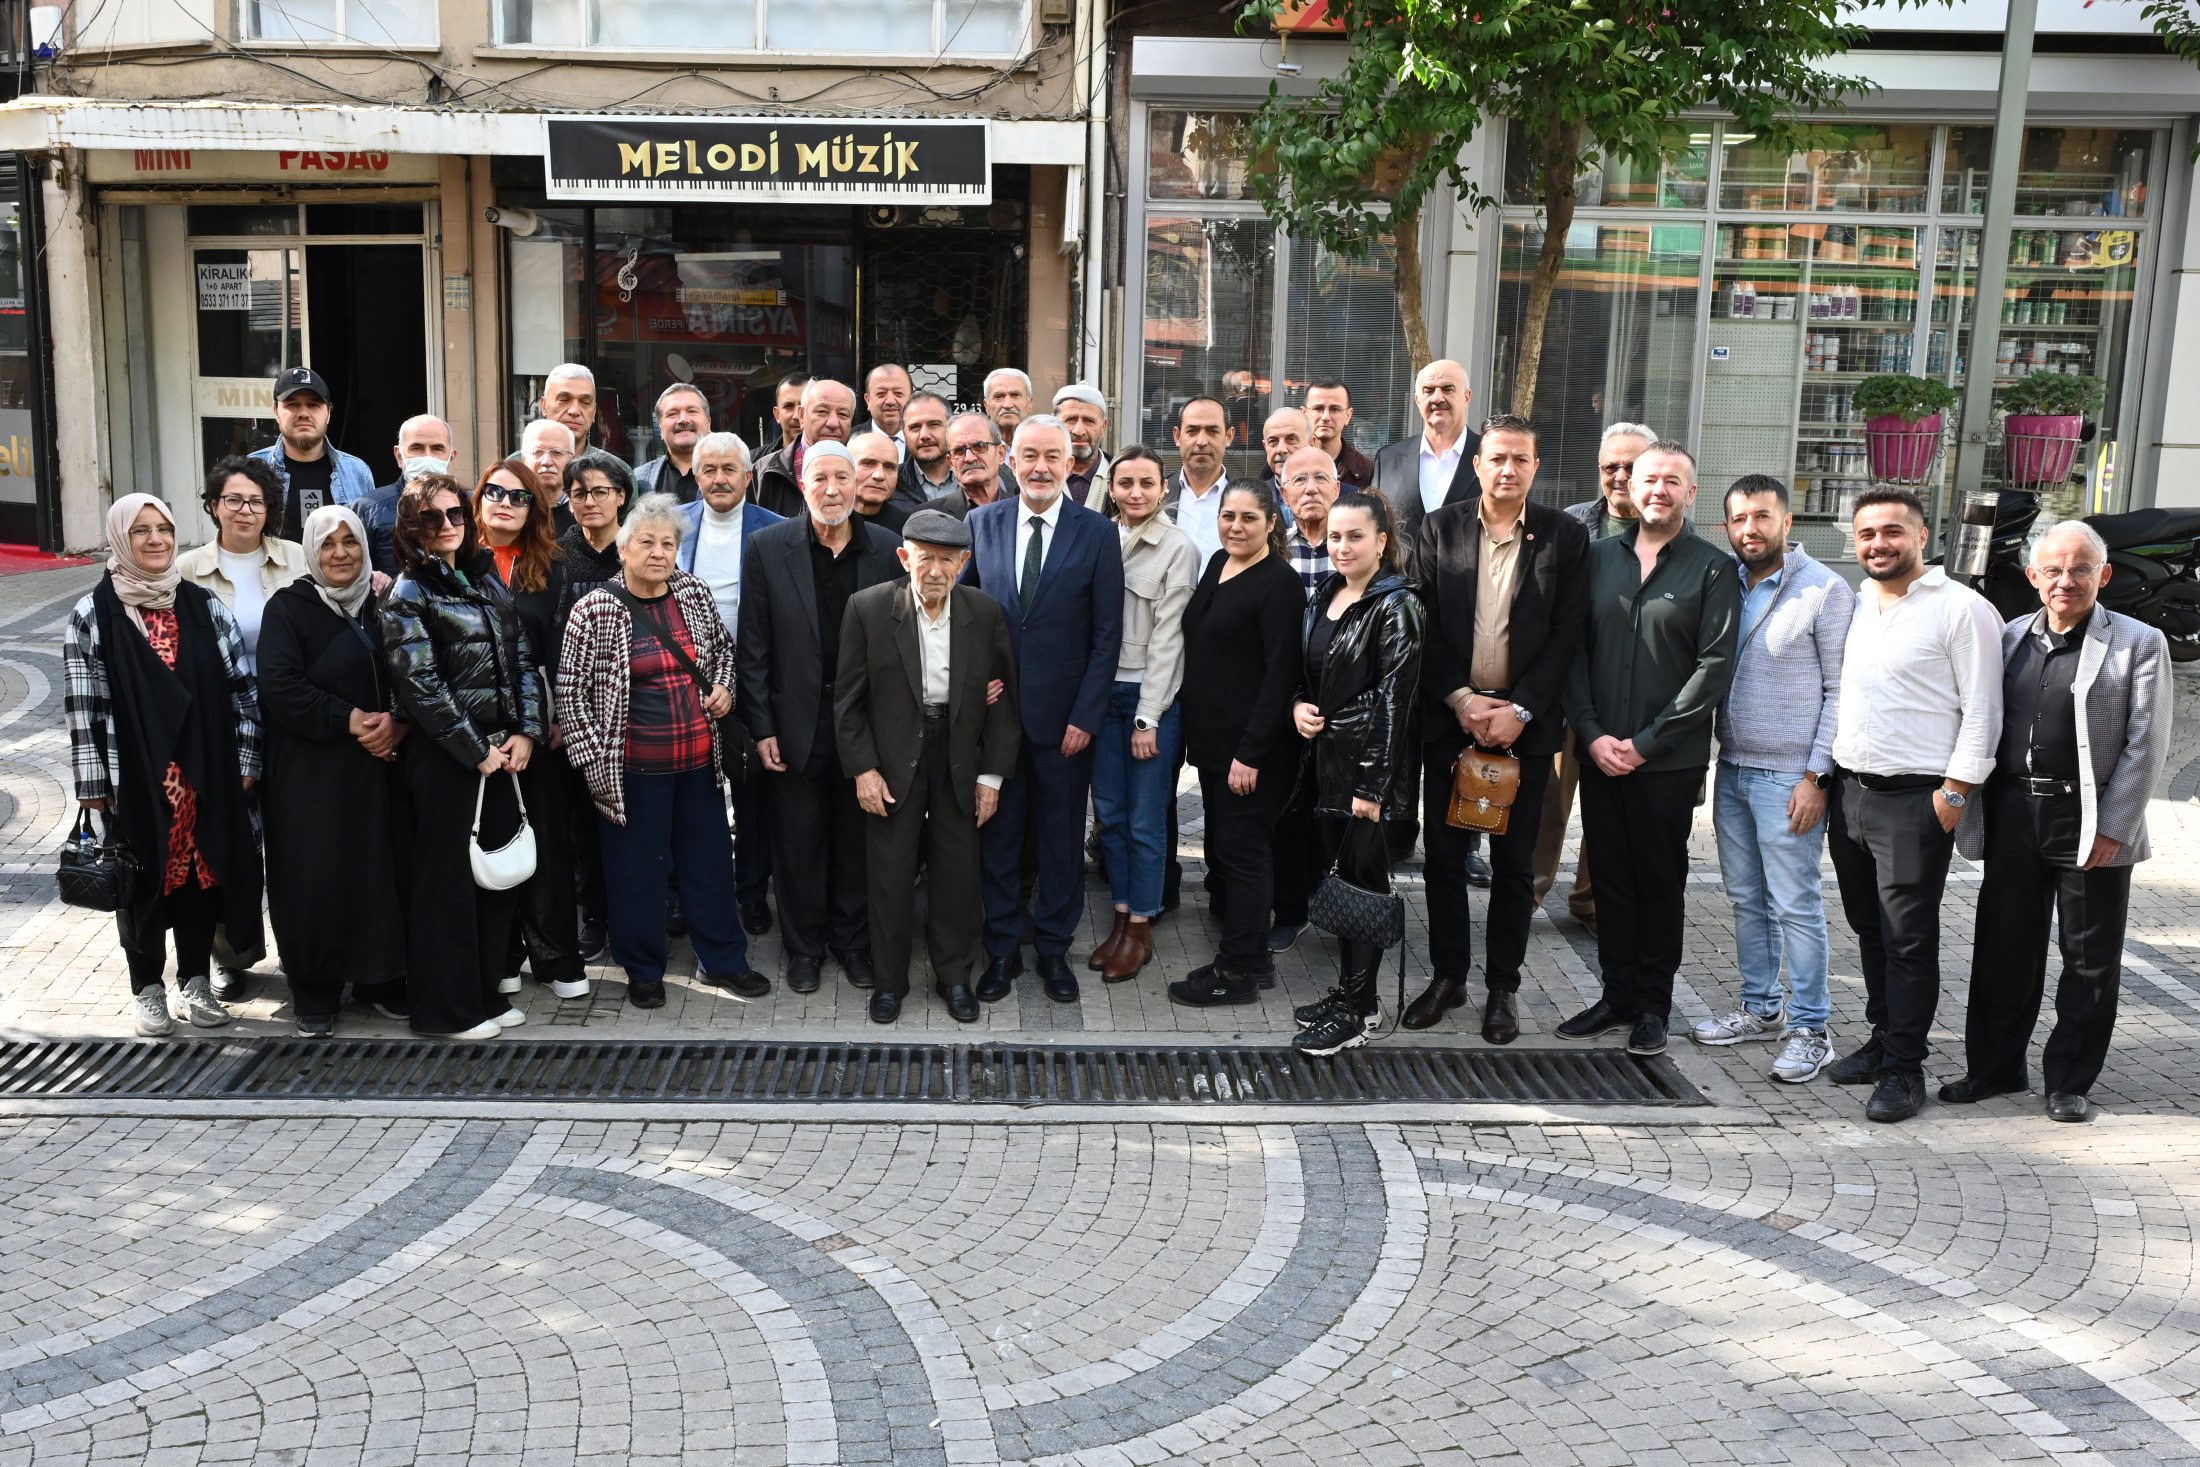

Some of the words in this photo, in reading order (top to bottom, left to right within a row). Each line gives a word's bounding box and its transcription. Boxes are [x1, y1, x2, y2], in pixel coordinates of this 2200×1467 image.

[795, 131, 919, 181] MÜZİK
[200, 266, 248, 279] KİRALIK
[201, 294, 216, 307] 0533
[219, 294, 229, 307] 371
[232, 294, 238, 307] 17
[241, 294, 248, 307] 37
[218, 388, 273, 407] MIN
